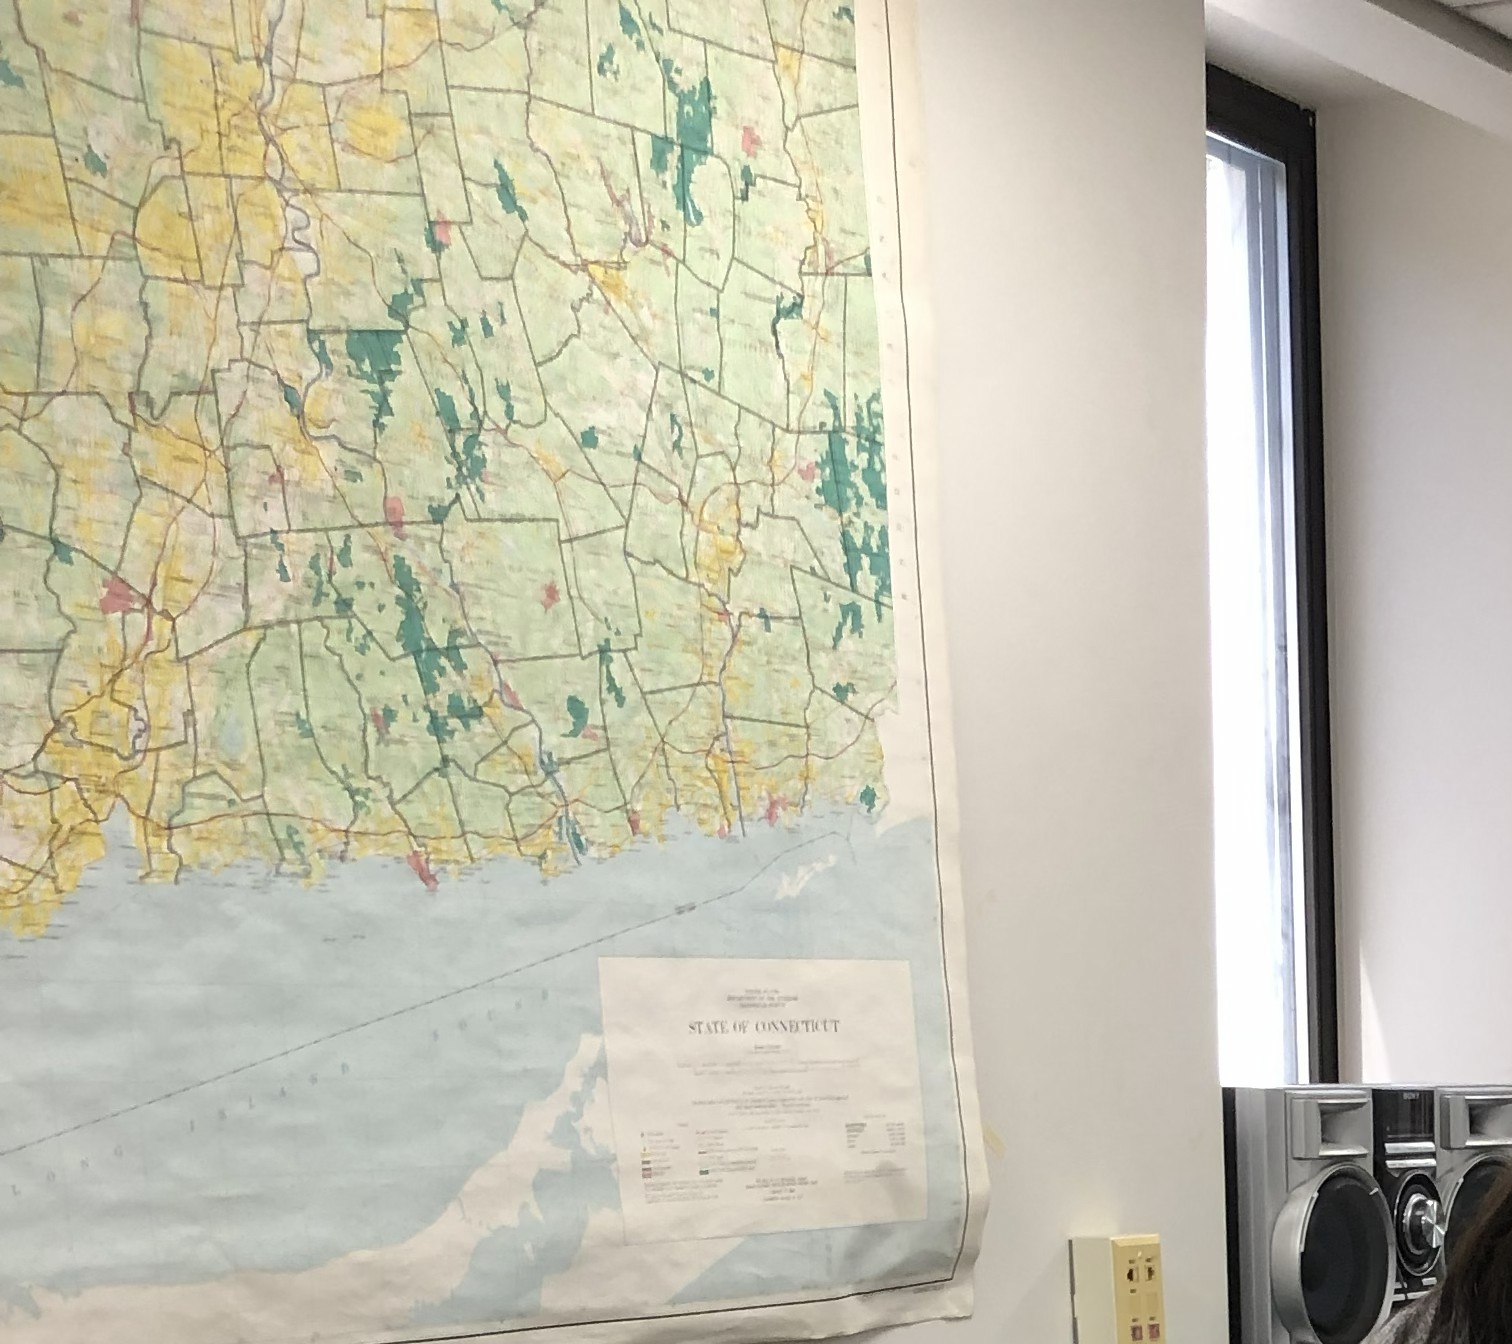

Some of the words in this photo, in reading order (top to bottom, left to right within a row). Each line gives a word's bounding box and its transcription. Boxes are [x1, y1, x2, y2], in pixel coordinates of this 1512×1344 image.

[688, 1020, 729, 1034] STATE
[732, 1020, 748, 1034] OF
[755, 1019, 840, 1033] CONNECTICUT
